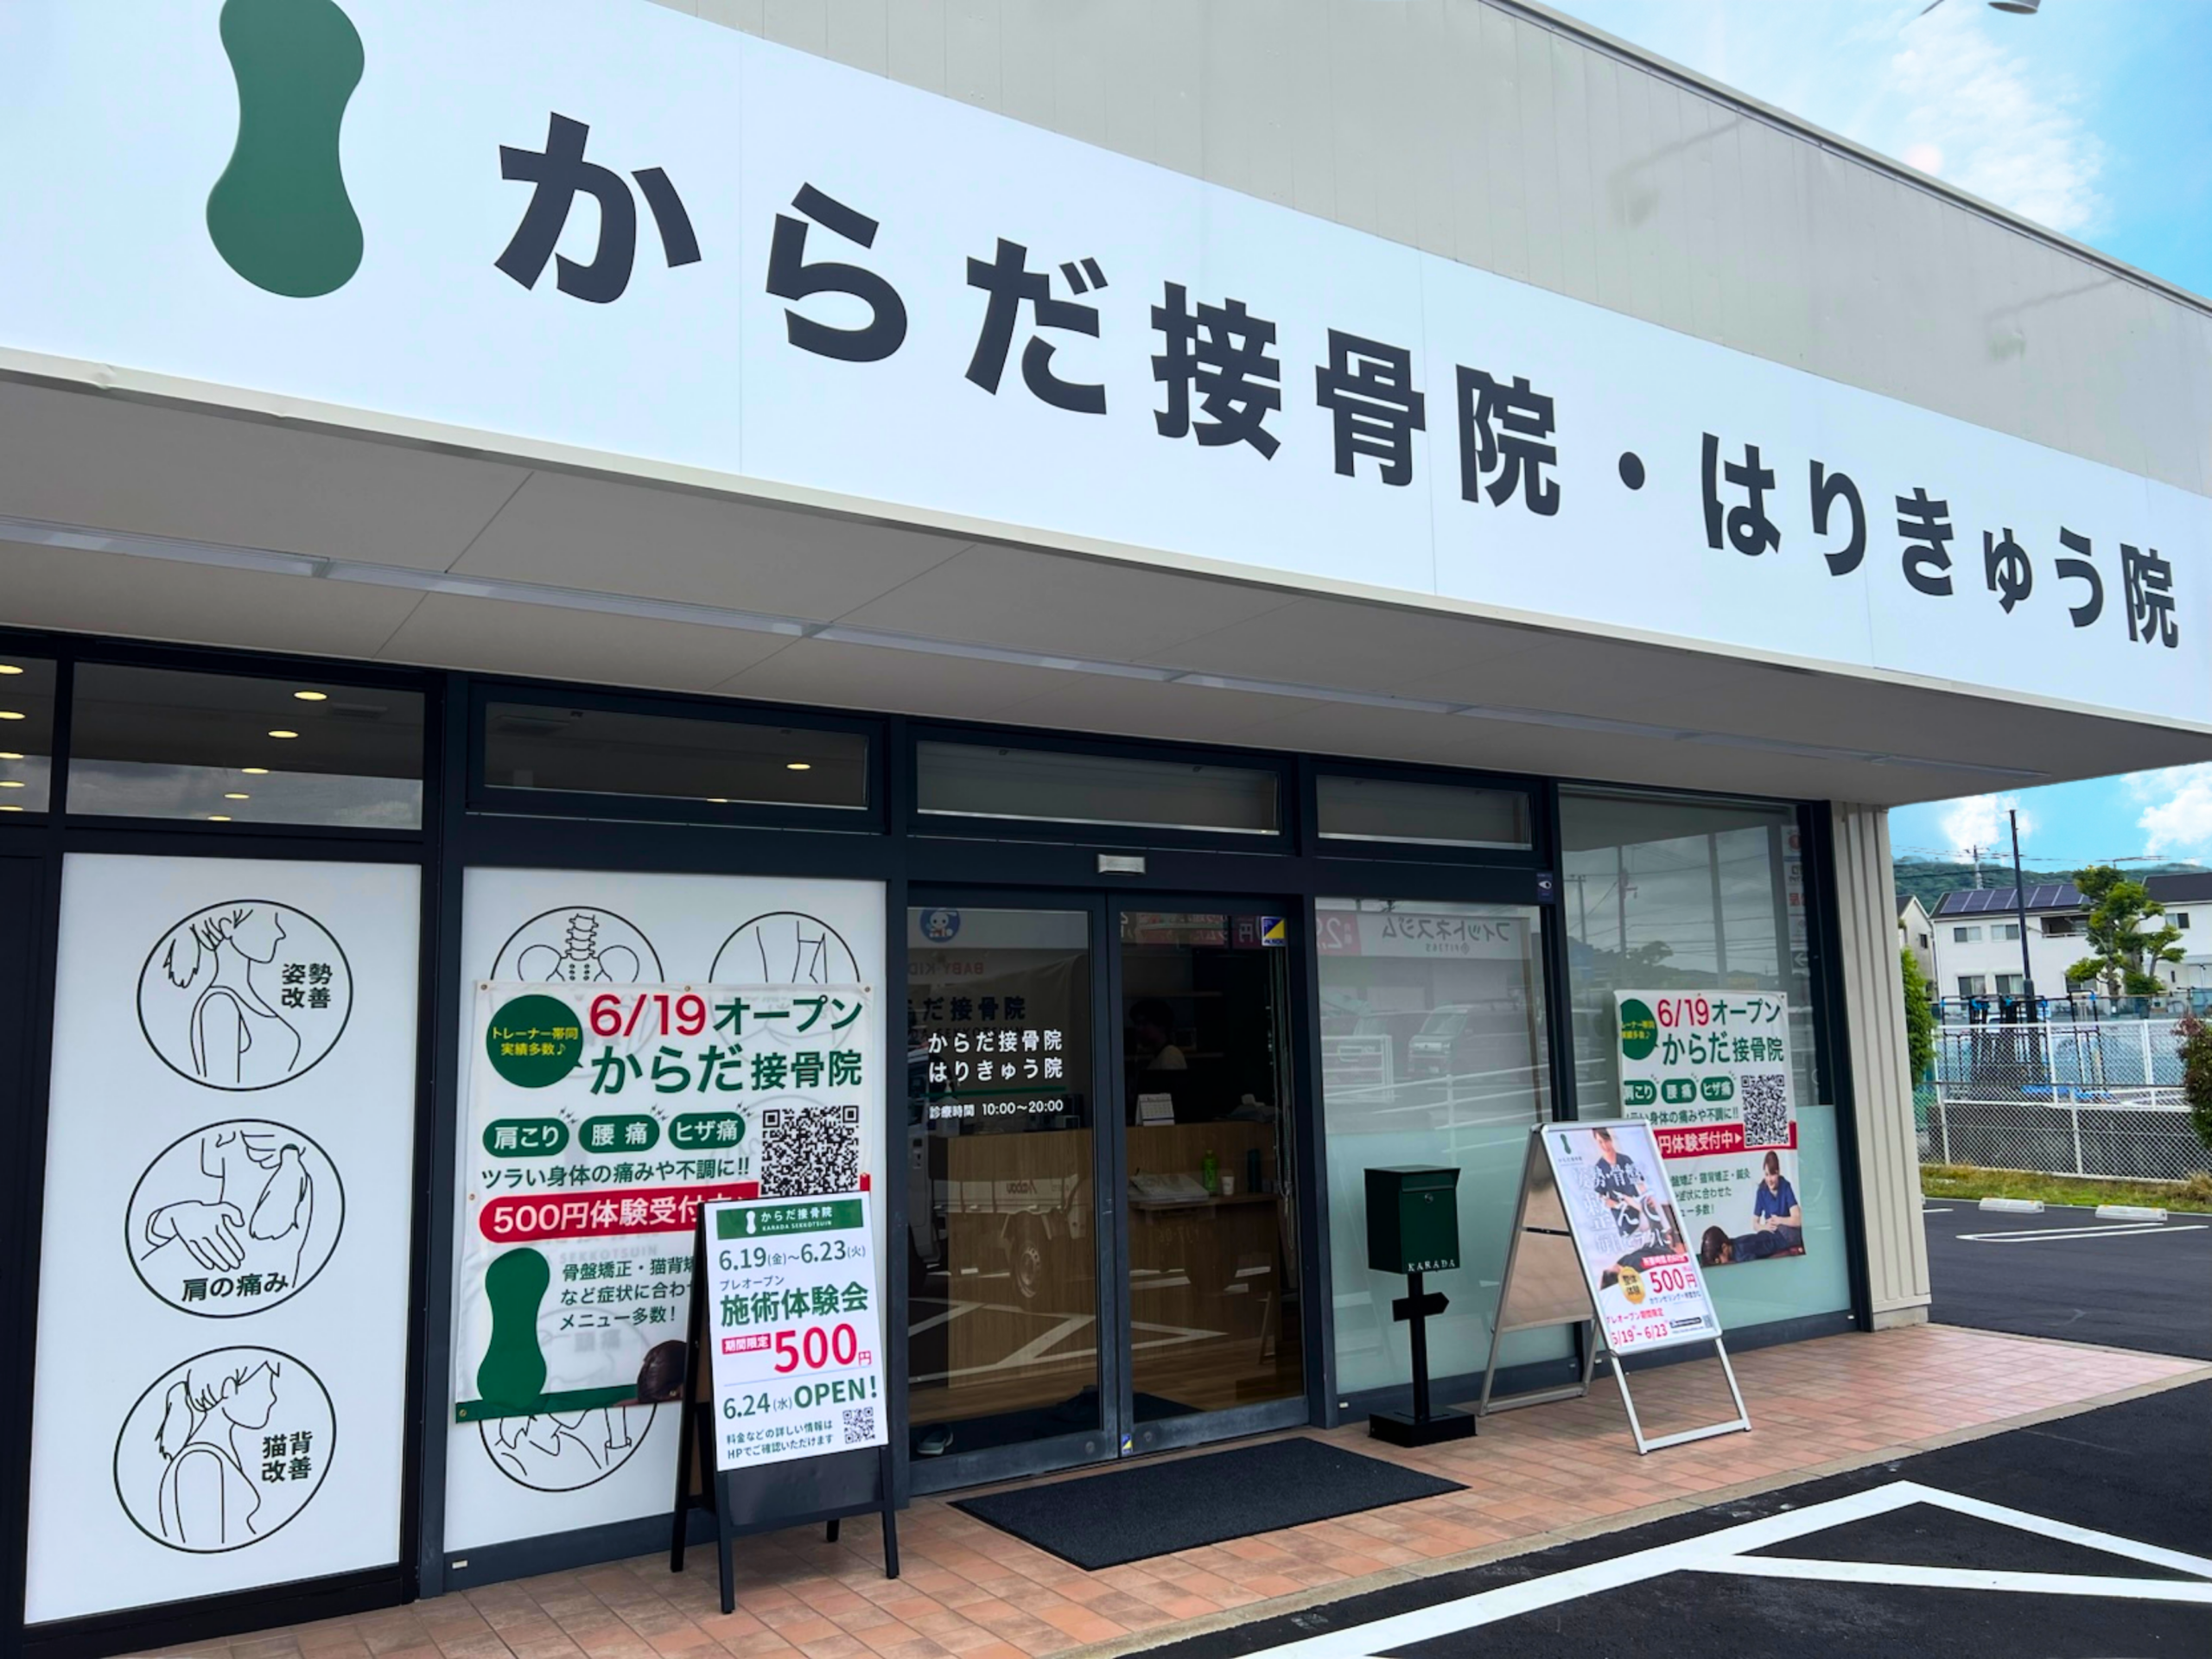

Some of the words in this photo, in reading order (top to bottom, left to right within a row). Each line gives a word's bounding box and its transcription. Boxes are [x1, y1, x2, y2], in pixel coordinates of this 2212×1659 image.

[493, 111, 2179, 650] からだ接骨院・はりきゅう院
[282, 963, 334, 985] 姿勢
[282, 988, 331, 1009] 改善
[493, 1027, 578, 1040] トレーナー帯同
[928, 1029, 1063, 1054] からだ接骨院
[1662, 1031, 1784, 1065] からだ接骨院
[590, 1043, 862, 1095] からだ接骨院
[928, 1057, 1064, 1084] はりきゅう院
[929, 1104, 976, 1120] 診療時間
[493, 1125, 561, 1150] 肩こり
[676, 1118, 739, 1142] ヒザ痛
[761, 1206, 833, 1224] からだ接骨院
[762, 1224, 790, 1232] KARADA
[1408, 1259, 1455, 1272] KARADA
[181, 1273, 289, 1301] 肩の痛み
[561, 1281, 691, 1306] など症状に合わ
[720, 1274, 785, 1292] プレオープン
[720, 1281, 868, 1327] 施術体験会
[724, 1337, 769, 1352] 期間限定
[262, 1431, 313, 1459] 猫背
[727, 1420, 833, 1445] 料金などの詳しい情報は
[728, 1433, 835, 1459] HPでご確認いただけます
[261, 1457, 312, 1483] 改善
